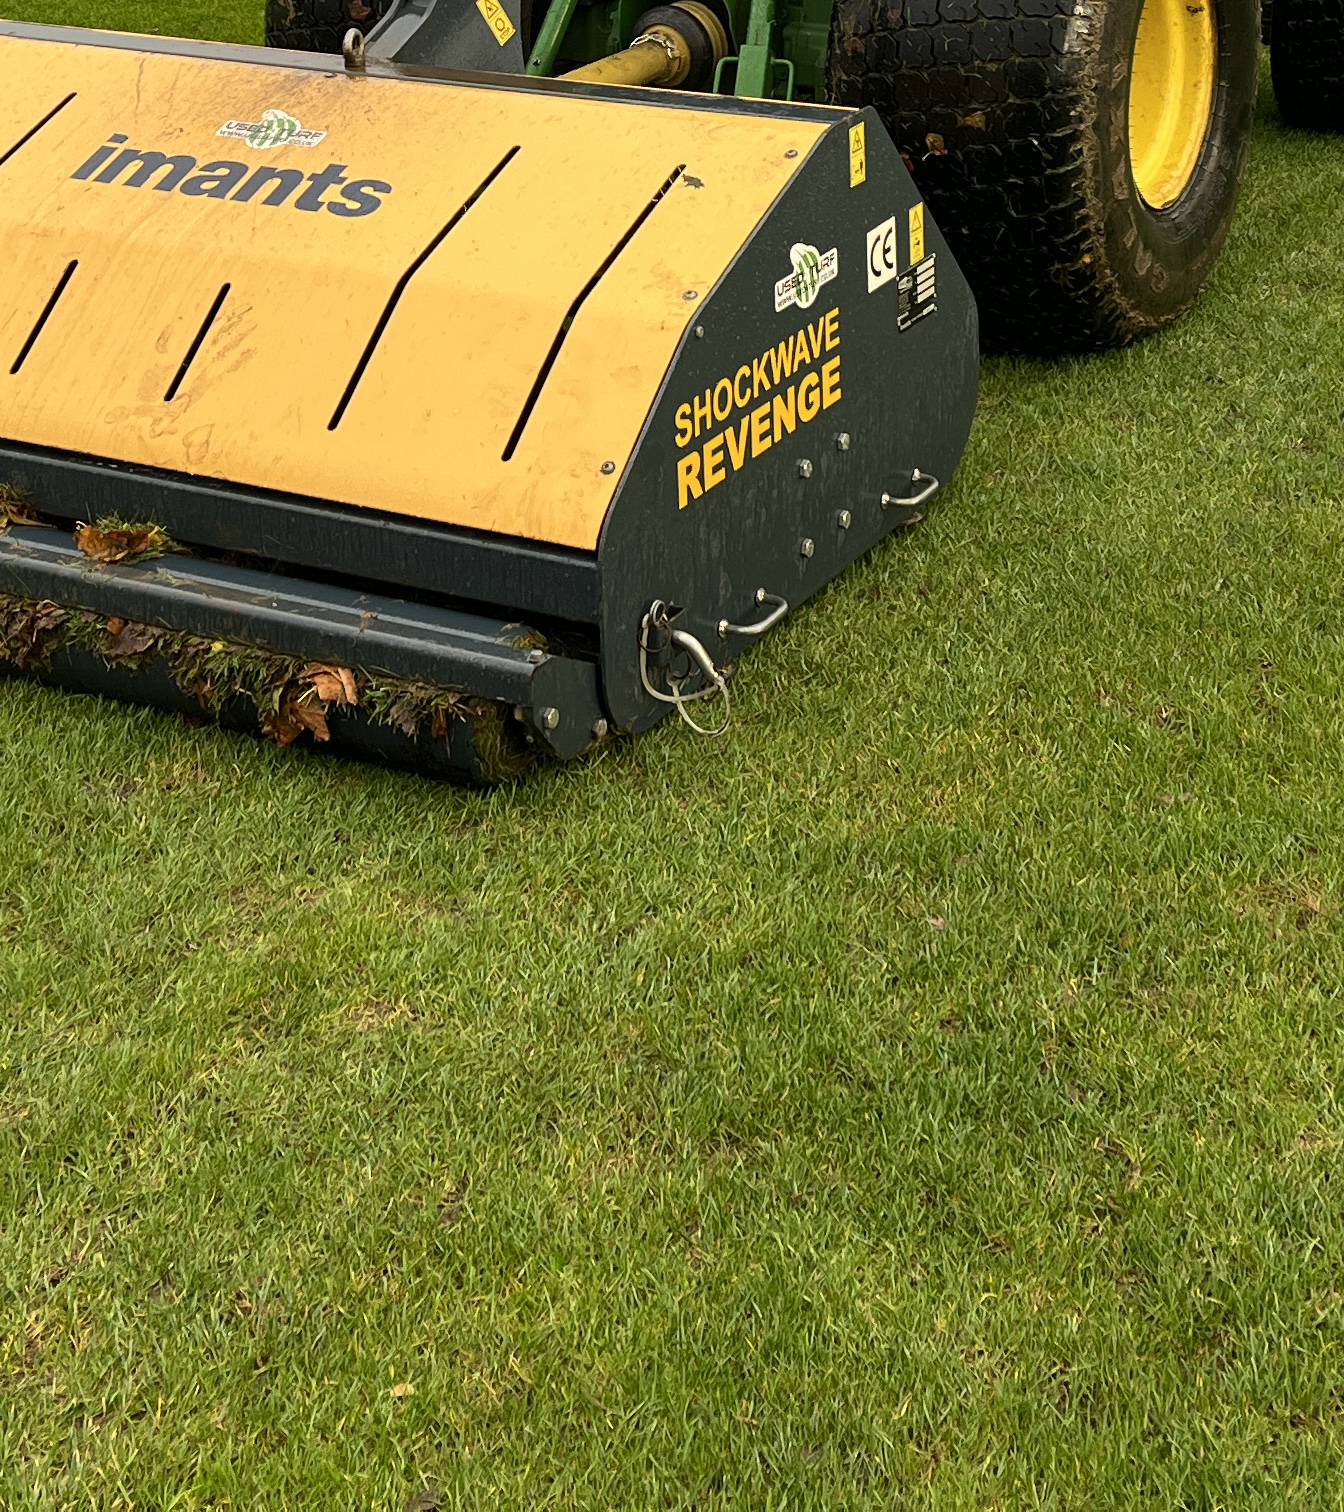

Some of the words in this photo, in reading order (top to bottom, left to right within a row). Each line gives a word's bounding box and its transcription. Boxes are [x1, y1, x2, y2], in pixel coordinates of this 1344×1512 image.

[70, 132, 392, 217] imants
[871, 226, 893, 277] CE
[674, 307, 841, 448] SHOCKWAVE
[676, 355, 842, 510] REVENGE
